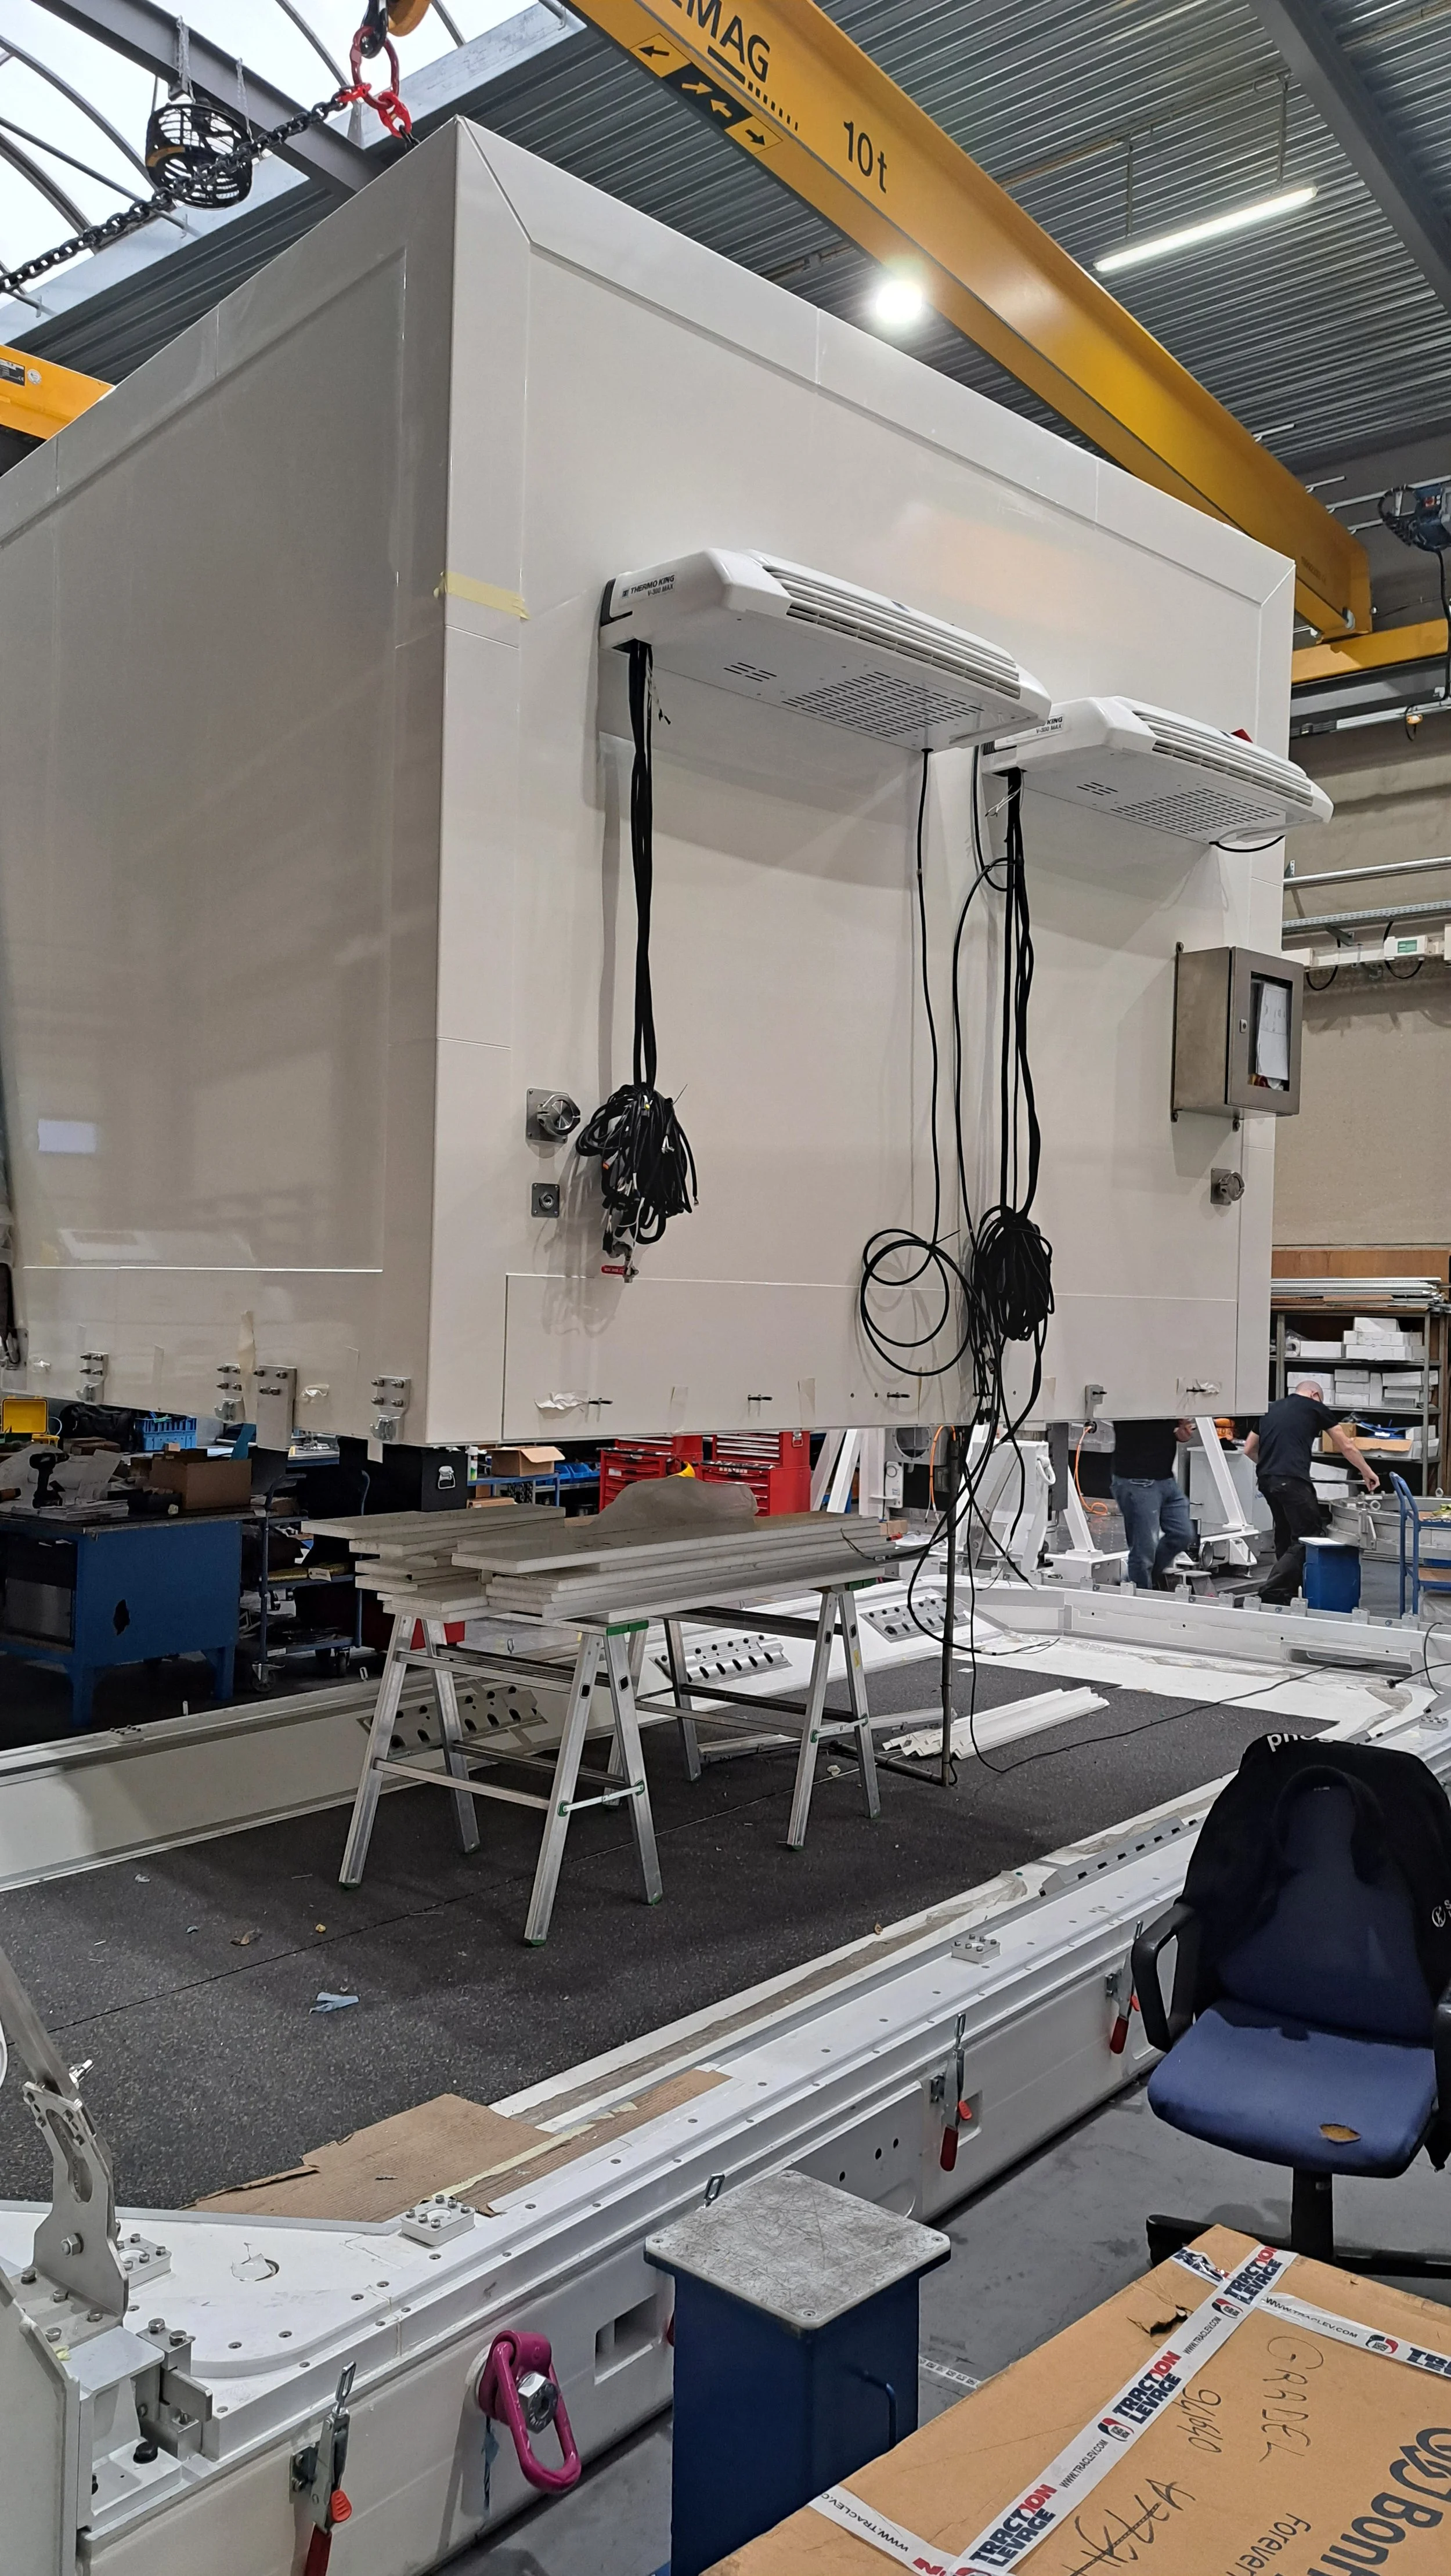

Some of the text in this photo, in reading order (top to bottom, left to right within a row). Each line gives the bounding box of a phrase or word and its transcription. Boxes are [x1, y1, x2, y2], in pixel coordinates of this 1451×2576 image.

[670, 0, 770, 83] MAG
[630, 575, 675, 594] THERMO KING
[662, 584, 673, 592] MAX
[1047, 716, 1063, 724] KING
[1235, 2259, 1283, 2305] LEVAGE
[1182, 2315, 1222, 2355] WWW.TRACLEV.COM
[1111, 2350, 1182, 2419] TRACTION
[1128, 2372, 1182, 2425] LEVAGE
[1258, 2336, 1324, 2462] GRADEL
[1058, 2438, 1109, 2488] WWW.TRACLEV.COM
[968, 2484, 1058, 2562] TRACTION
[987, 2508, 1056, 2567] LEVAGE
